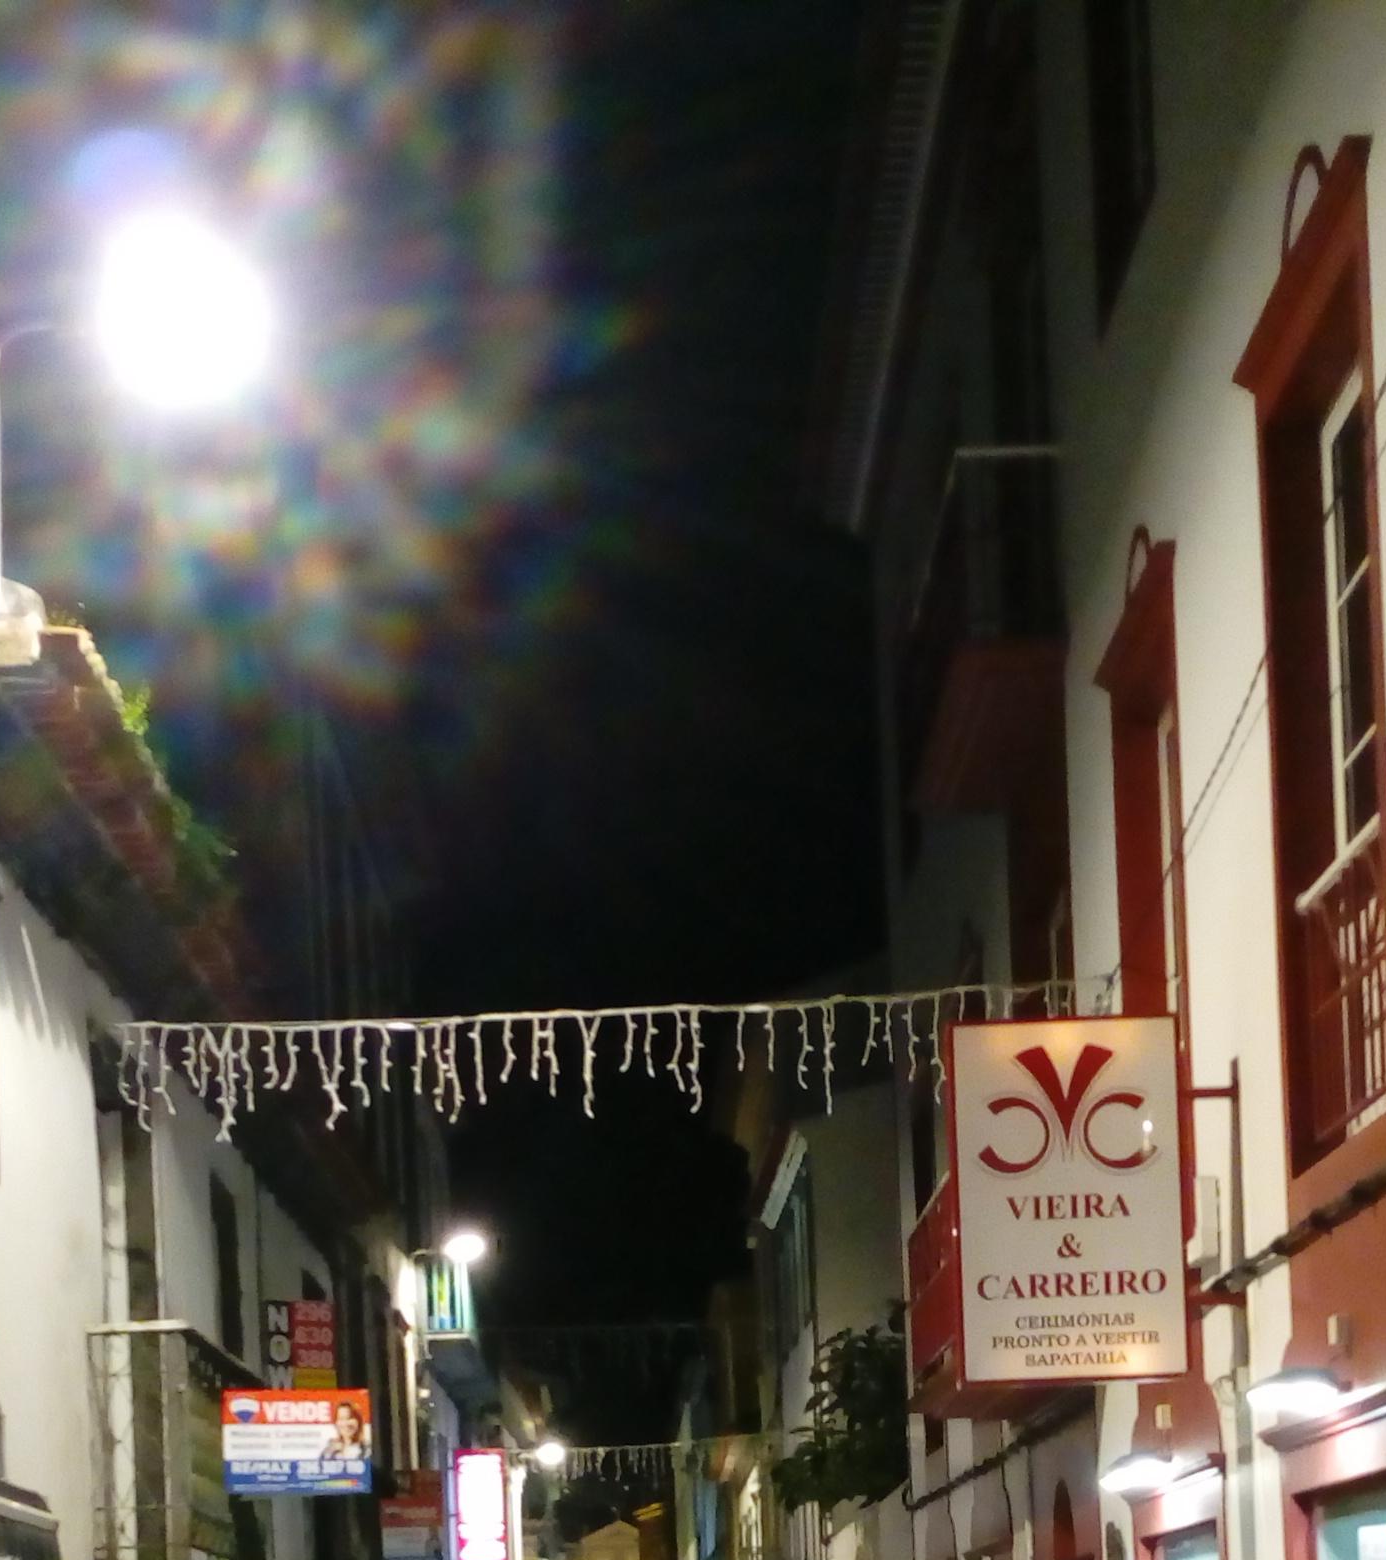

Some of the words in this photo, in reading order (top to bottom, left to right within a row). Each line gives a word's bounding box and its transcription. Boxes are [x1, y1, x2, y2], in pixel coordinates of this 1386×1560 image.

[1006, 1193, 1131, 1221] VIEIRA
[1056, 1232, 1082, 1260] &
[976, 1268, 1168, 1301] CARREIRO
[1015, 1311, 1135, 1330] CERIMÓNIAS
[991, 1333, 1070, 1349] PRONTO
[1076, 1334, 1088, 1347] A
[1093, 1330, 1160, 1346] VESTIR
[1025, 1351, 1128, 1367] SAPATARIA
[261, 1401, 331, 1423] VENDE
